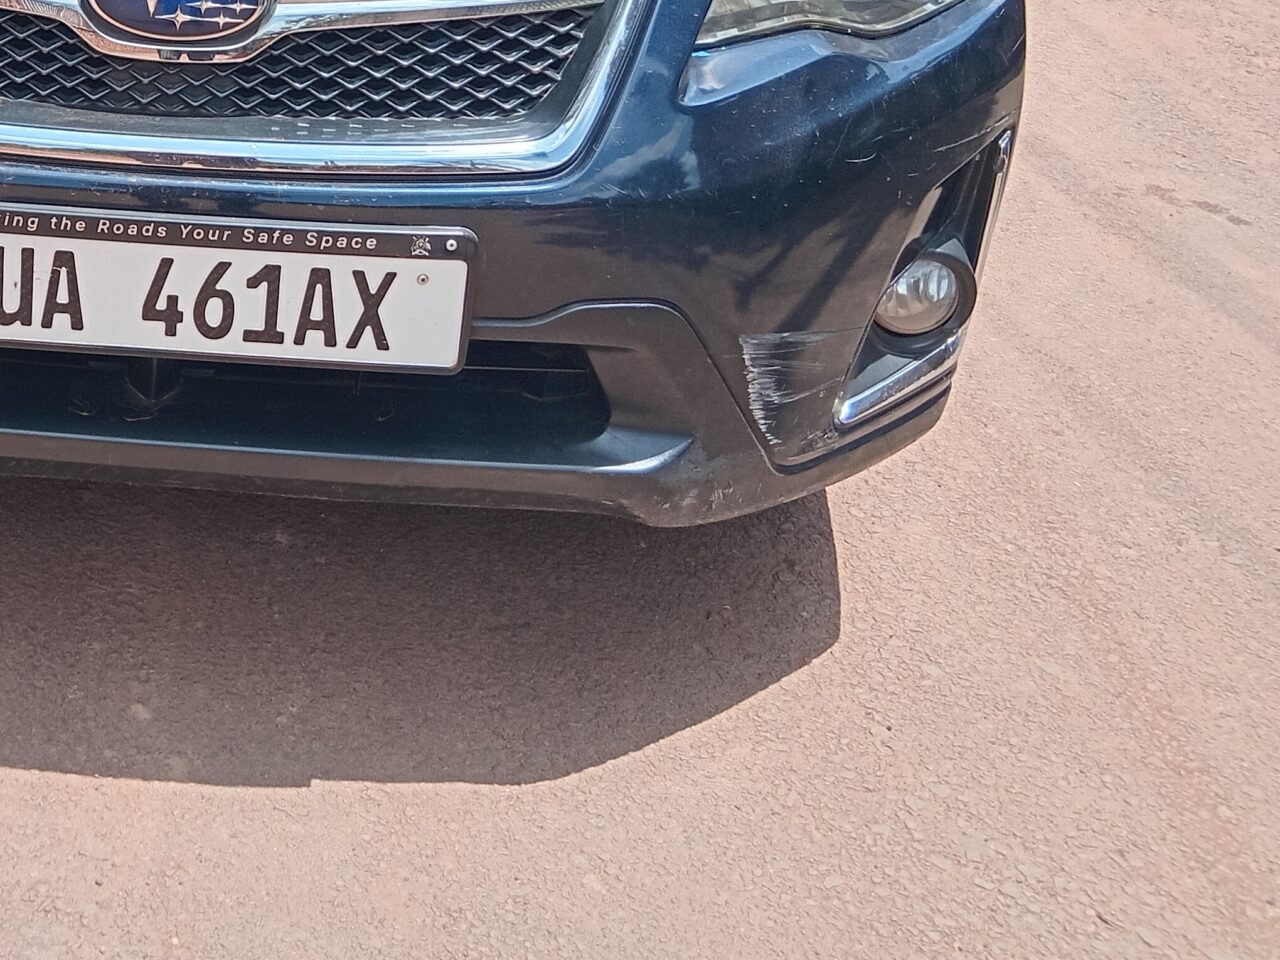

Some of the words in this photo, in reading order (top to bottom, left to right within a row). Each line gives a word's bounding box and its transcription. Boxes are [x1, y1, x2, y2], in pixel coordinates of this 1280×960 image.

[50, 215, 86, 232] the
[97, 219, 168, 238] Roads
[180, 224, 232, 241] Your
[242, 228, 294, 246] Safe
[305, 231, 378, 250] Space
[141, 257, 398, 351] 461AX
